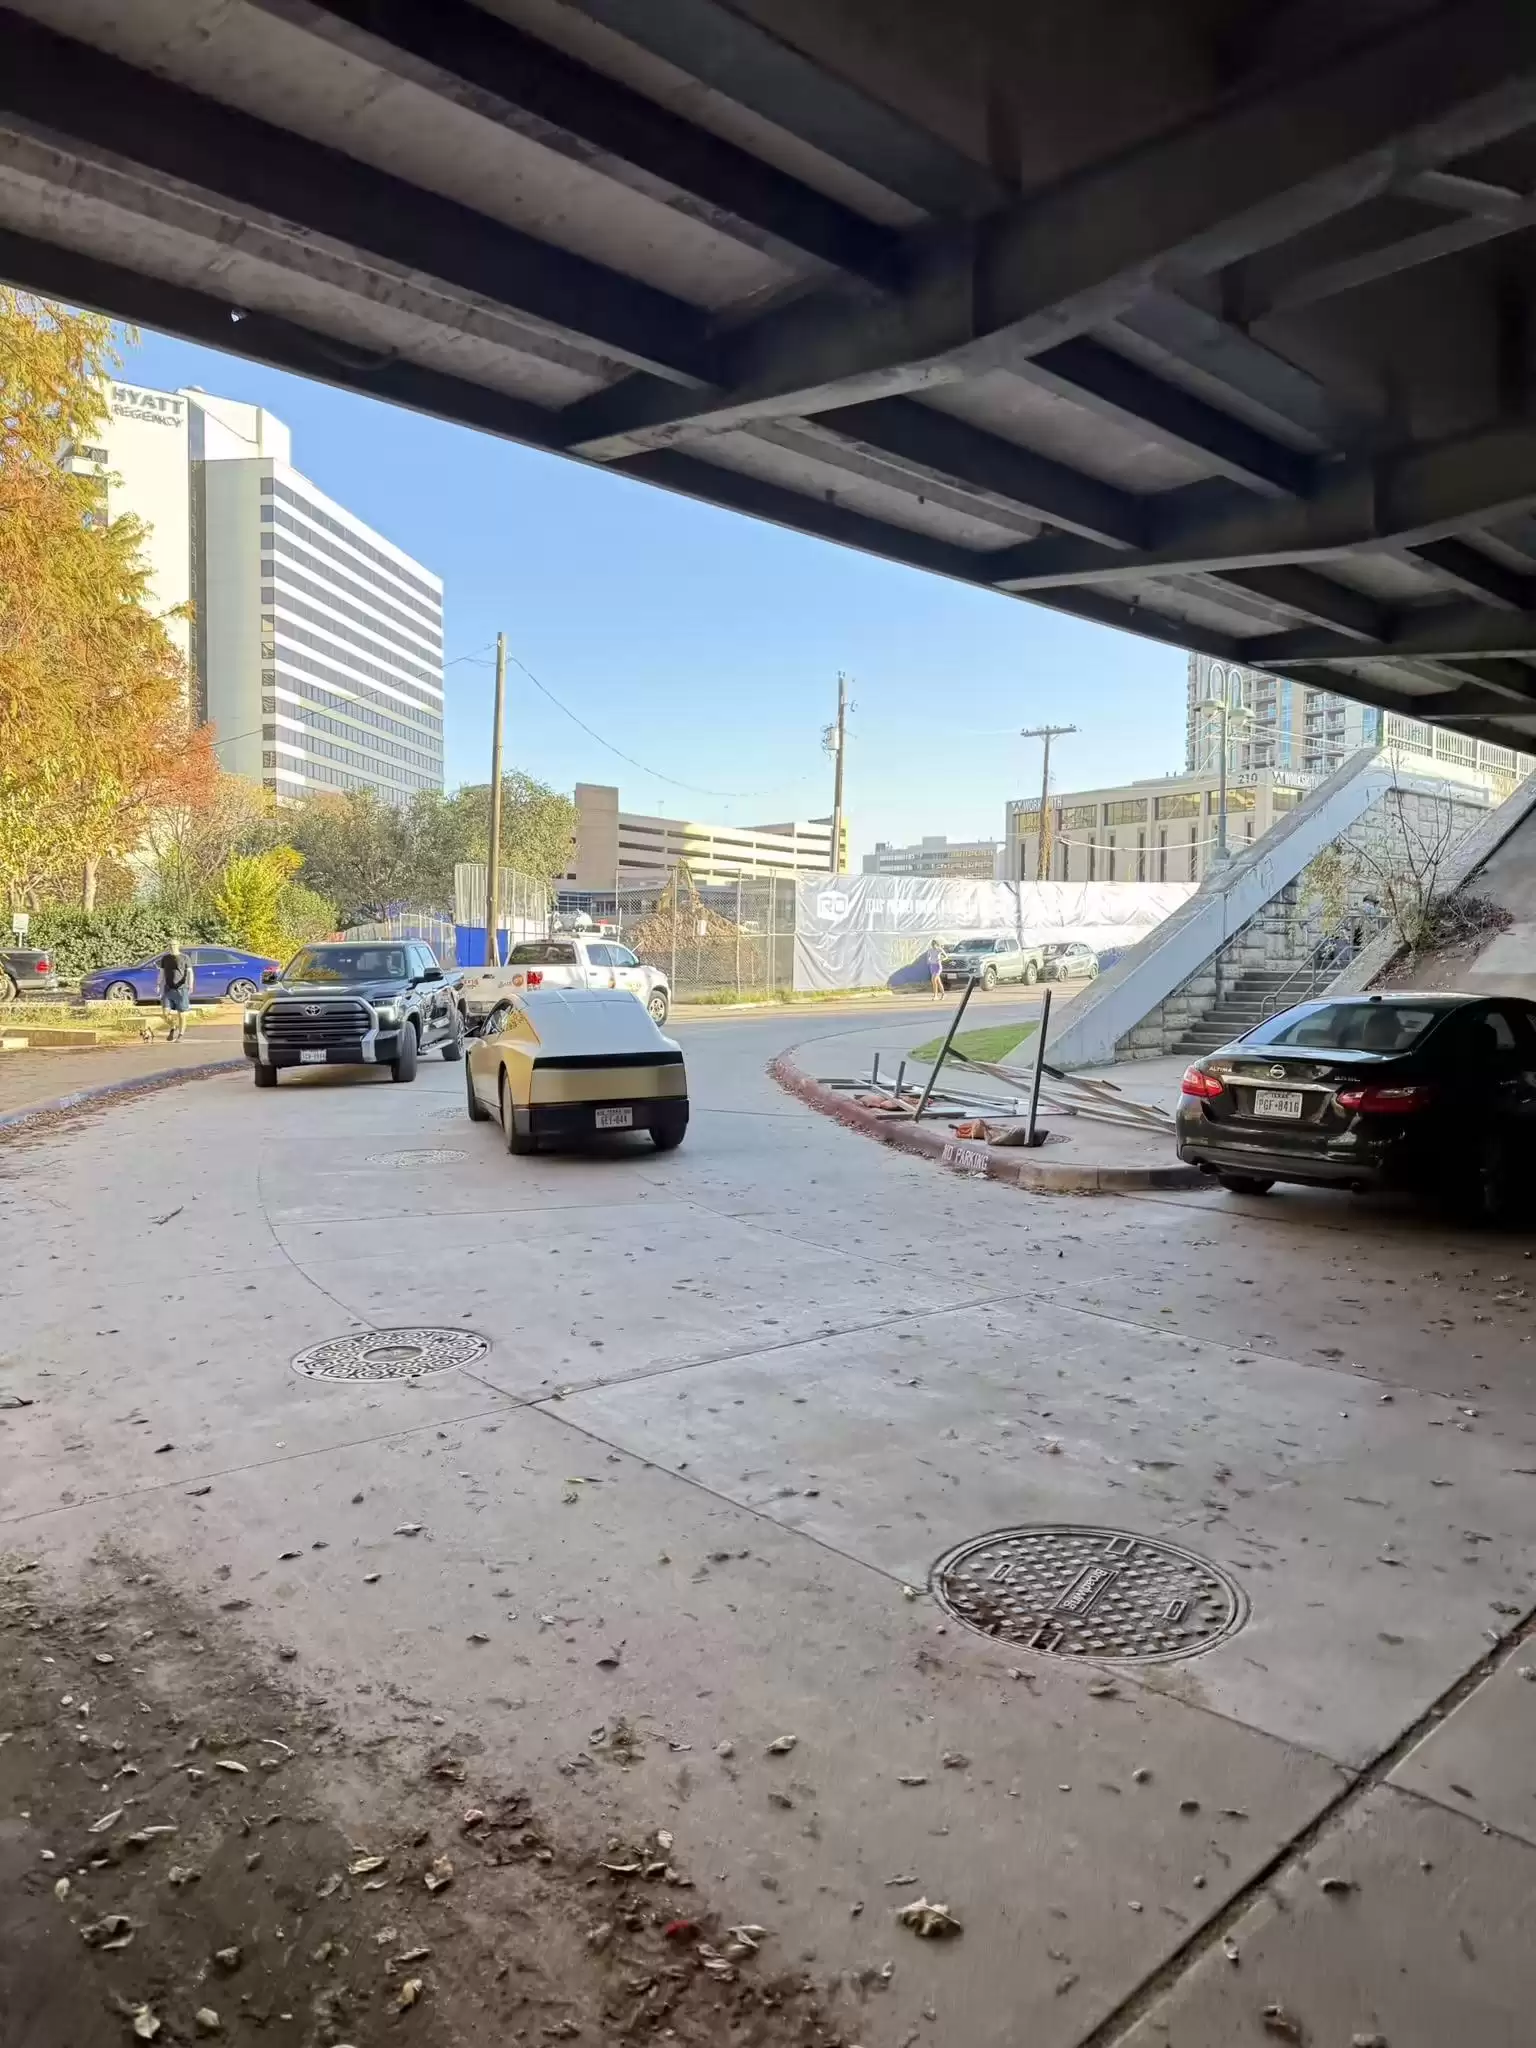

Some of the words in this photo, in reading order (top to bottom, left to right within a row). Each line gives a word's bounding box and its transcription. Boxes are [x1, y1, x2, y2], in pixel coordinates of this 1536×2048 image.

[111, 386, 184, 414] HYATT
[112, 404, 183, 428] REGENCY
[941, 1143, 954, 1161] NO
[955, 1148, 989, 1171] PARKING
